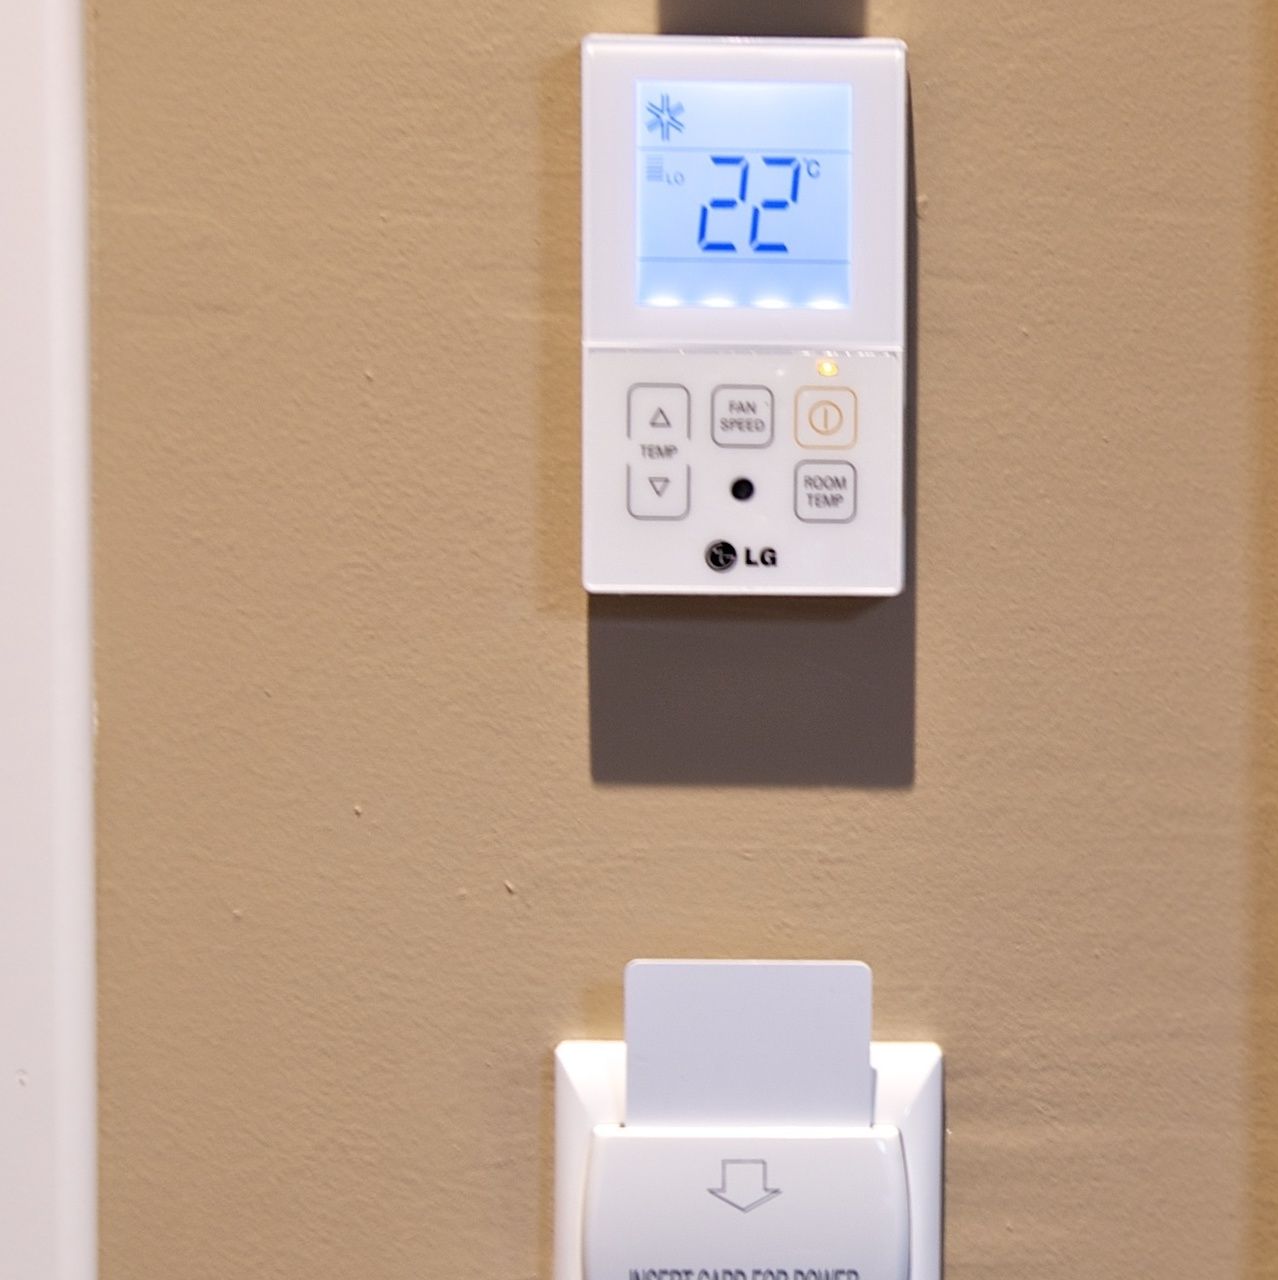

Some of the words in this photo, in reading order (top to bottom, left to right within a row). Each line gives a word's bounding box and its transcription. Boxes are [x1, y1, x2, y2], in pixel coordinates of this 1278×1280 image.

[728, 400, 757, 415] FAN
[720, 418, 766, 433] SPEED
[640, 443, 678, 459] TEMP
[804, 475, 847, 490] ROOM
[806, 493, 844, 508] TEMP
[745, 547, 777, 567] LG
